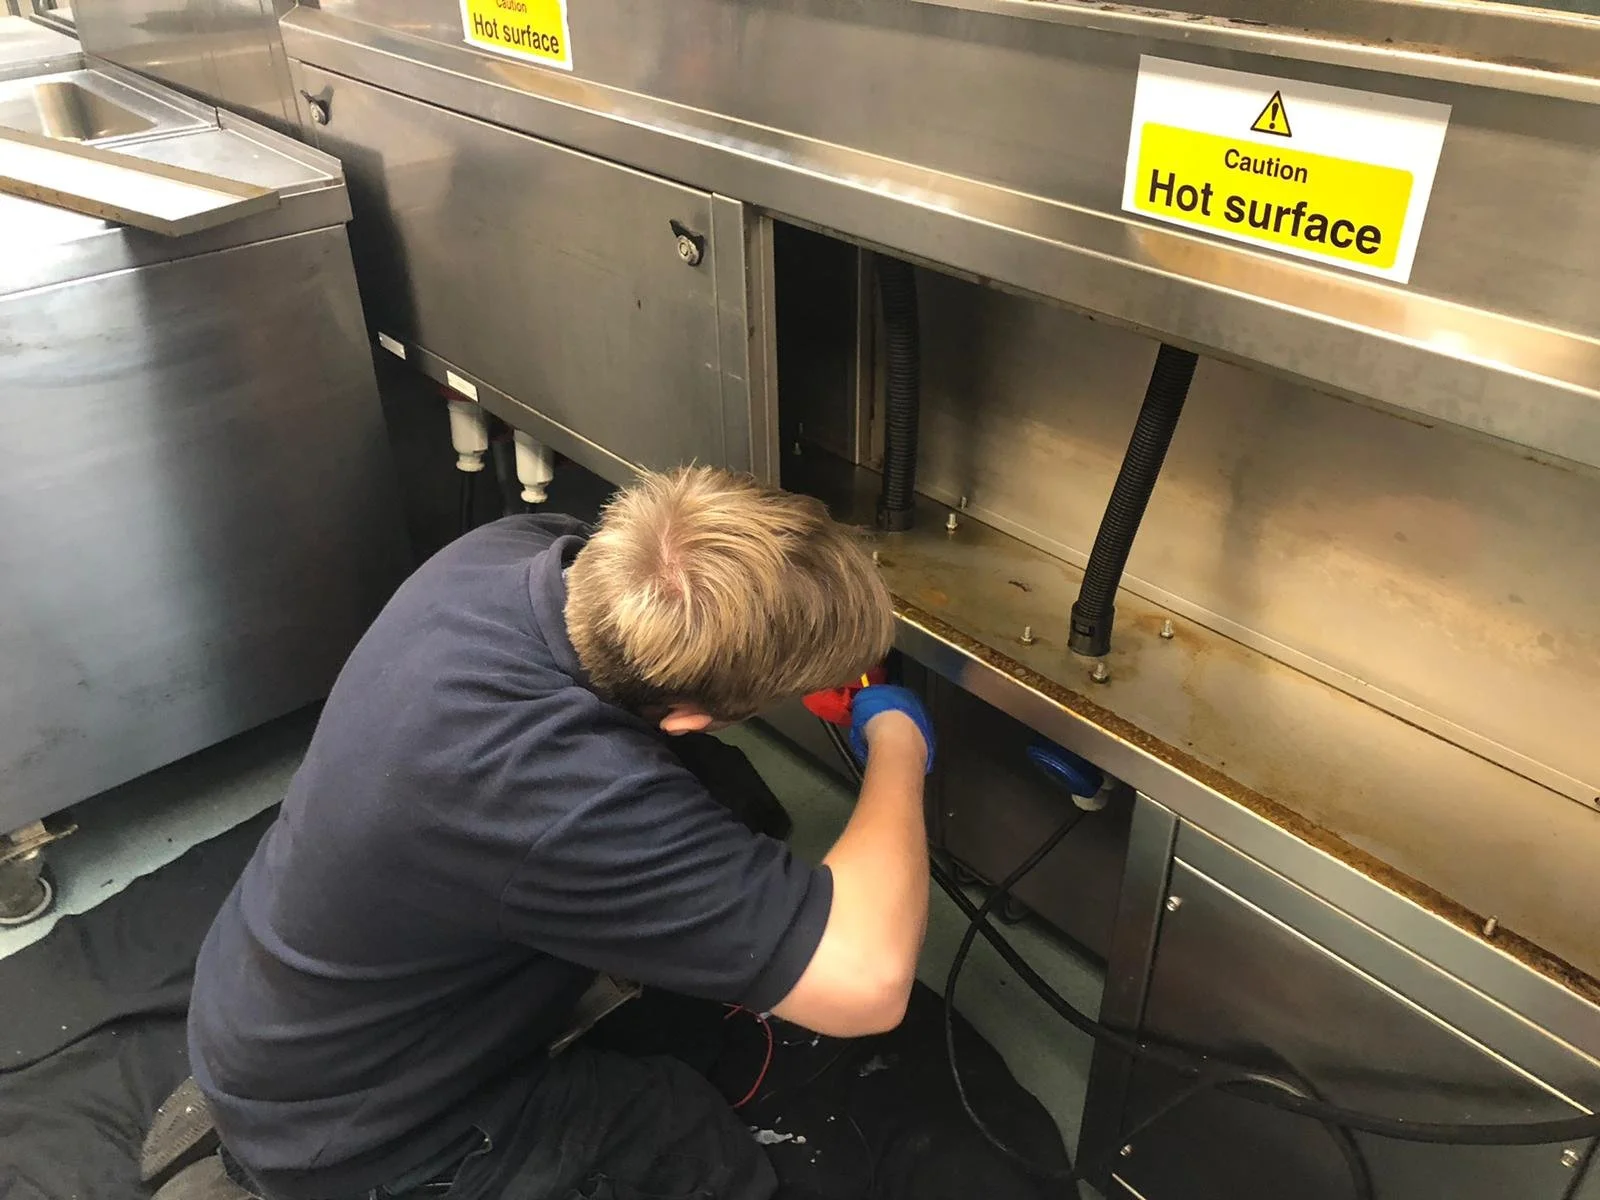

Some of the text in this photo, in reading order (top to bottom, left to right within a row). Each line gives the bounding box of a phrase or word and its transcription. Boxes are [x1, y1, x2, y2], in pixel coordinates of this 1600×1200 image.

[496, 0, 527, 14] Caution
[473, 12, 559, 54] Hot surface
[1224, 148, 1308, 183] Caution
[1148, 168, 1382, 255] Hot surface
